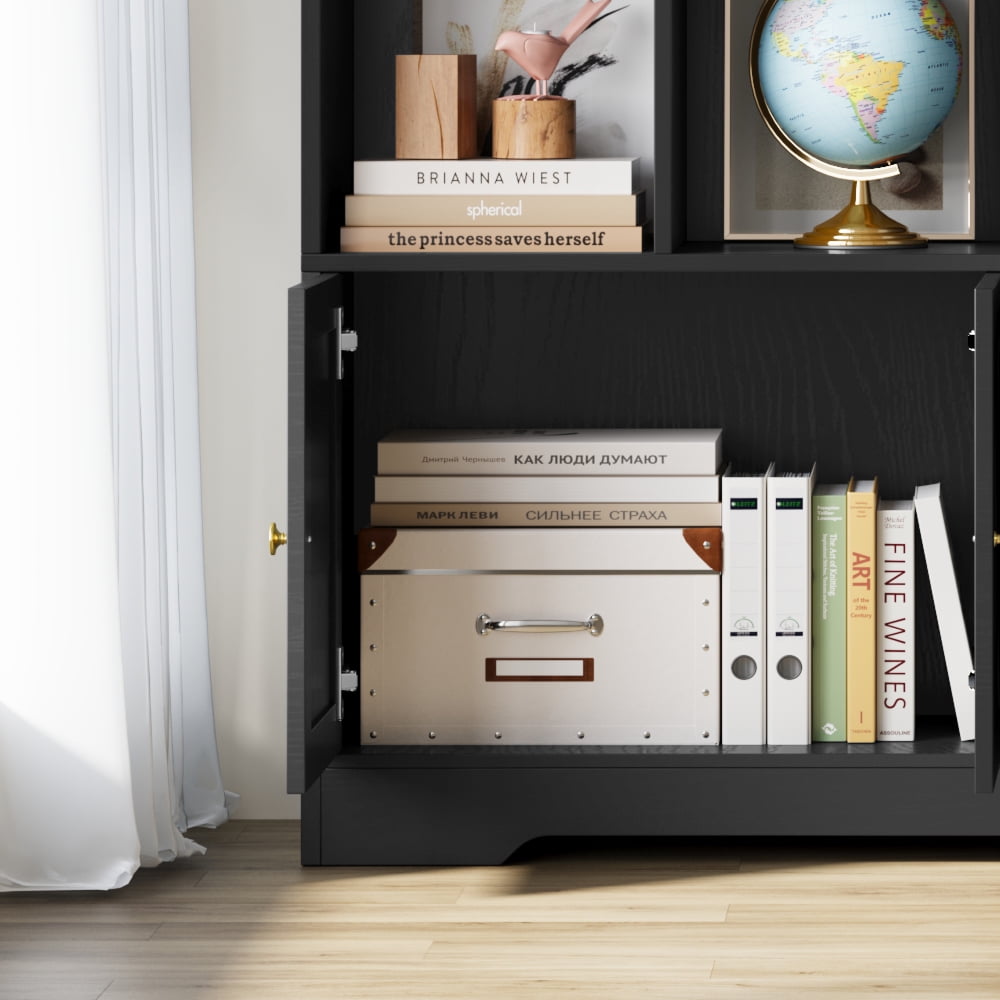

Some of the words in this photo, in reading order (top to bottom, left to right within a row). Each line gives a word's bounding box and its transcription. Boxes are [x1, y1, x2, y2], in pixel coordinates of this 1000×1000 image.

[416, 171, 504, 184] BRIANNA
[515, 171, 572, 184] WIEST
[466, 199, 522, 220] spherical
[388, 232, 417, 246] the
[544, 231, 606, 246] herself
[421, 455, 459, 464] Дмитрий
[513, 454, 544, 466] КАК
[548, 454, 597, 467] ЛЮДИ
[599, 454, 668, 467] ДУМАЮТ
[416, 511, 457, 520] МАРК
[459, 511, 499, 520] ЛЕВИ
[525, 510, 602, 521] СИЛЬНЕЕ
[609, 510, 668, 521] СТРАХА
[828, 568, 838, 595] Knitting
[852, 552, 871, 590] ART
[884, 543, 906, 604] FINE
[884, 618, 906, 709] WINES
